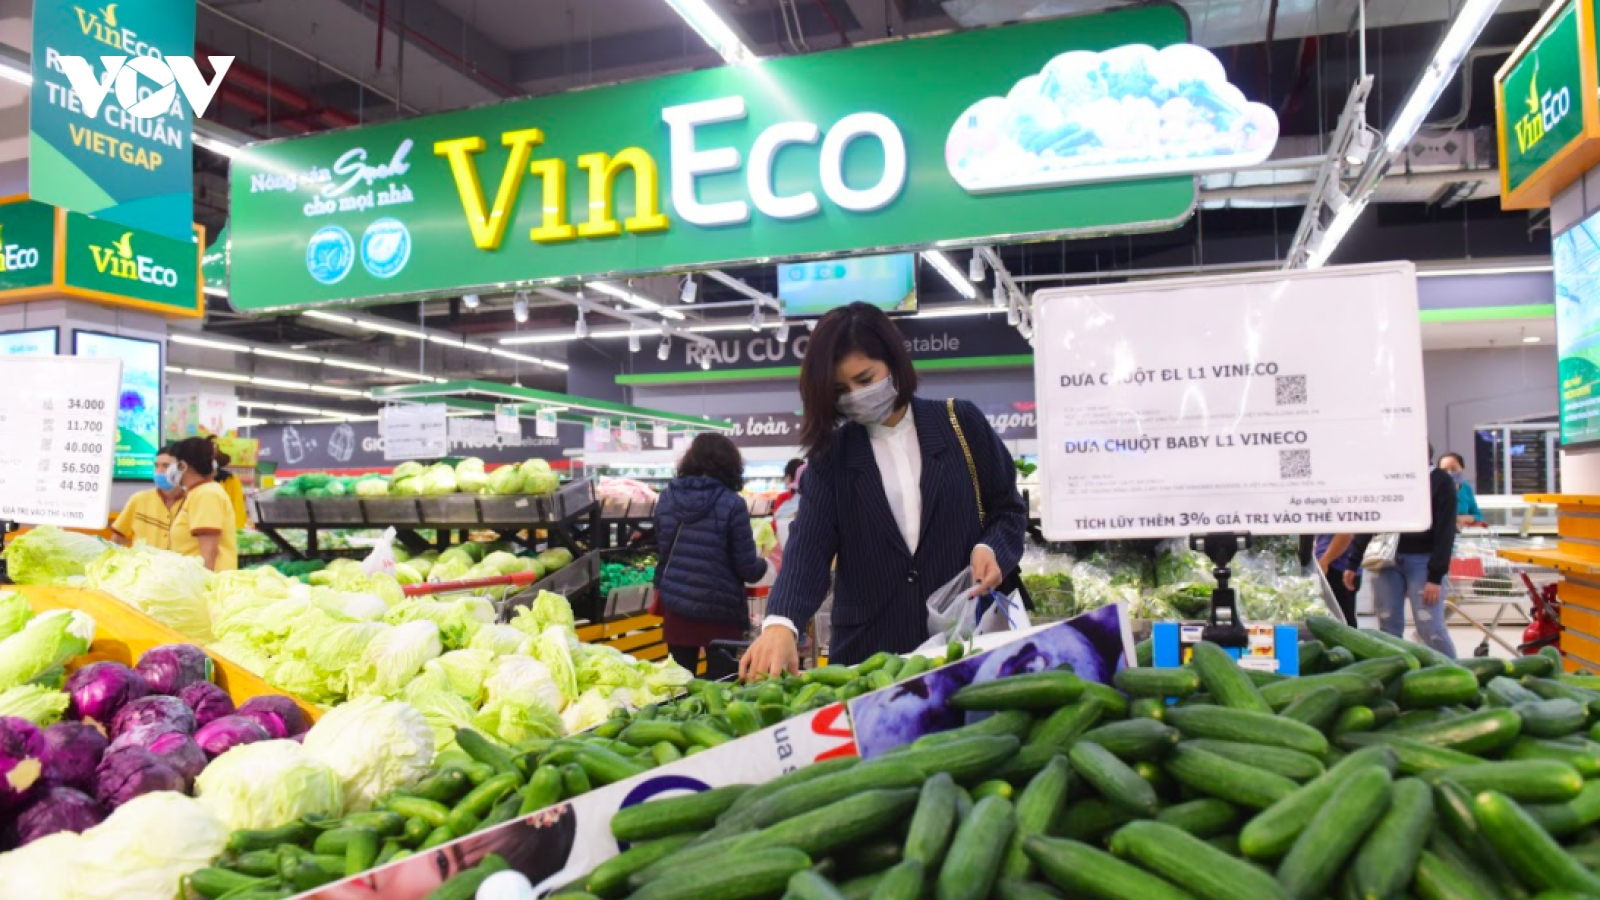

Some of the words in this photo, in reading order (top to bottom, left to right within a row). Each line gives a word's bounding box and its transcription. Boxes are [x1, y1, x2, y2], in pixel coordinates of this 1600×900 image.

[73, 5, 162, 59] VinEco
[1514, 86, 1570, 155] VinEco
[69, 123, 163, 171] VIETGAP
[433, 94, 908, 250] VinEco
[303, 195, 336, 217] cho
[339, 190, 375, 212] mọi
[377, 183, 414, 206] nhà
[88, 243, 178, 288] VinEco
[1060, 372, 1096, 388] DƯA
[1161, 368, 1182, 382] ĐL
[1187, 366, 1207, 379] L1
[1212, 361, 1279, 378] VINECO
[67, 398, 105, 410] 34.000
[67, 420, 103, 432] 11.700
[64, 442, 103, 453] 40.000
[1065, 436, 1100, 454] DƯA
[1104, 434, 1161, 454] CHUỘT
[1166, 434, 1210, 450] BABY
[1215, 433, 1235, 448] L1
[1240, 429, 1308, 447] VINECO
[62, 462, 100, 474] 56.500
[59, 480, 99, 492] 44.500
[1074, 514, 1106, 530] TÍCH
[1110, 514, 1135, 528] LŨY
[1138, 513, 1175, 528] THÊM
[1179, 512, 1211, 527] 3%
[1273, 509, 1301, 524] VÀO
[1337, 511, 1381, 522] VINID
